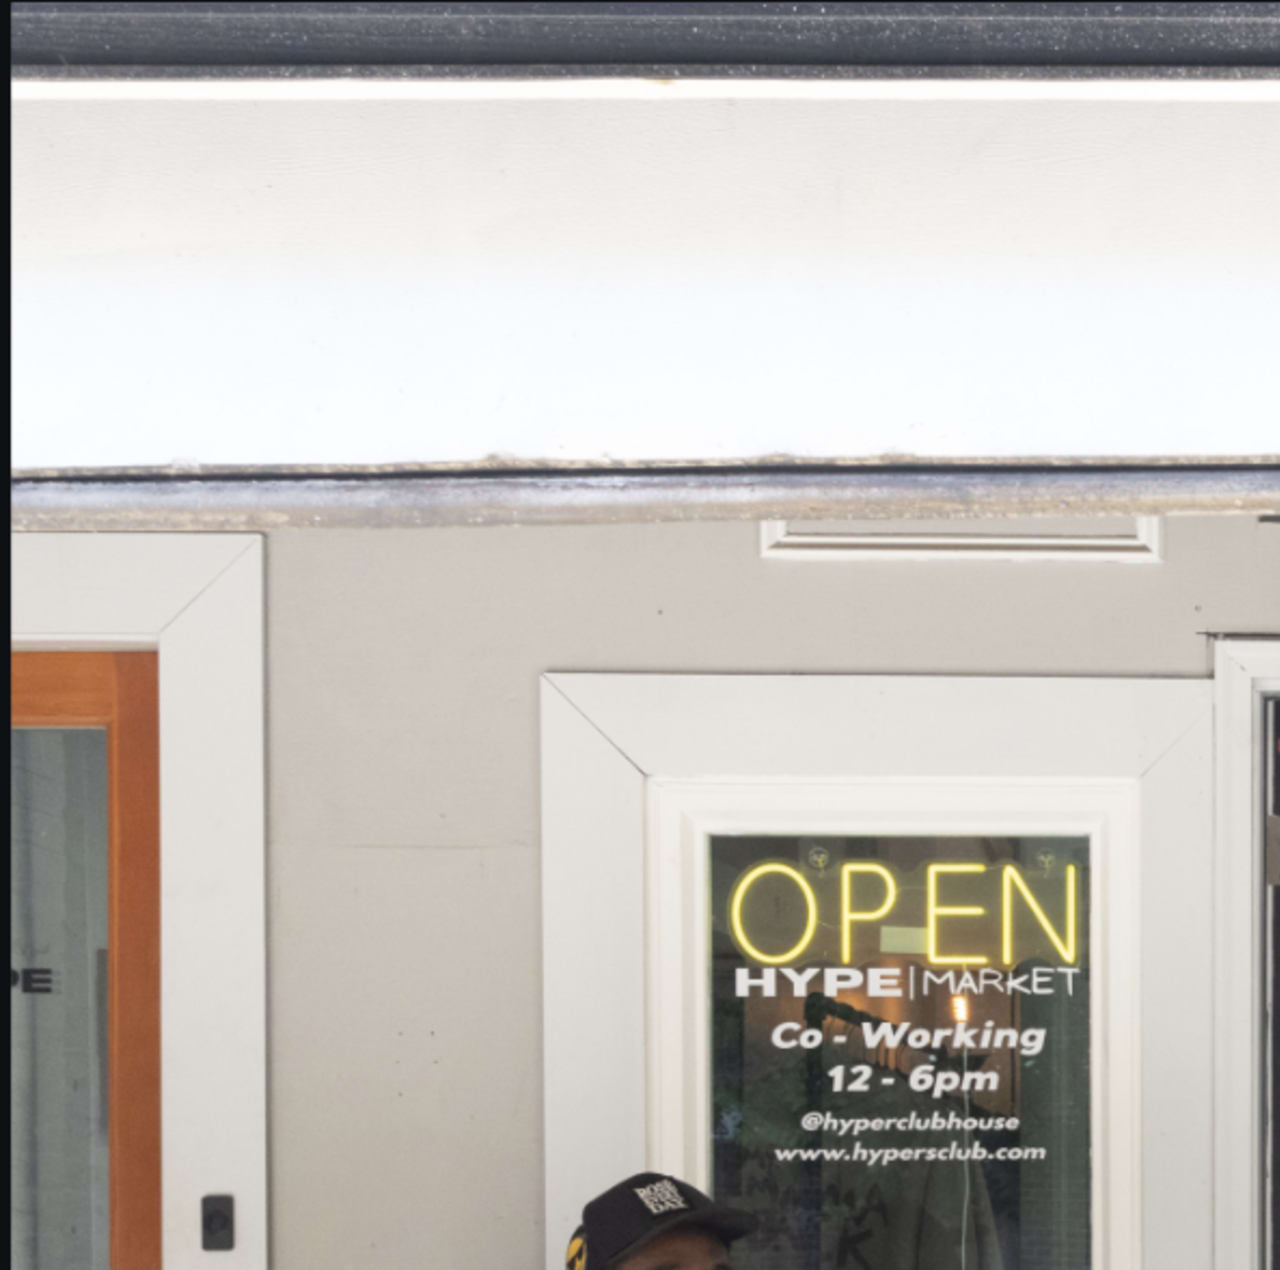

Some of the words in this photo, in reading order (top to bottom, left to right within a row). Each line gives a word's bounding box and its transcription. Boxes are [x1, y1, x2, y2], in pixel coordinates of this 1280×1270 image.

[731, 863, 1076, 964] OPEN
[735, 967, 903, 998] HYPE
[923, 967, 1081, 997] MARKET
[861, 1021, 1047, 1056] Working
[827, 1065, 872, 1092] 12
[909, 1065, 1000, 1098] 6pm
[802, 1112, 1020, 1135] @hyperclubhouse
[775, 1141, 1046, 1165] www.hypersclub.com
